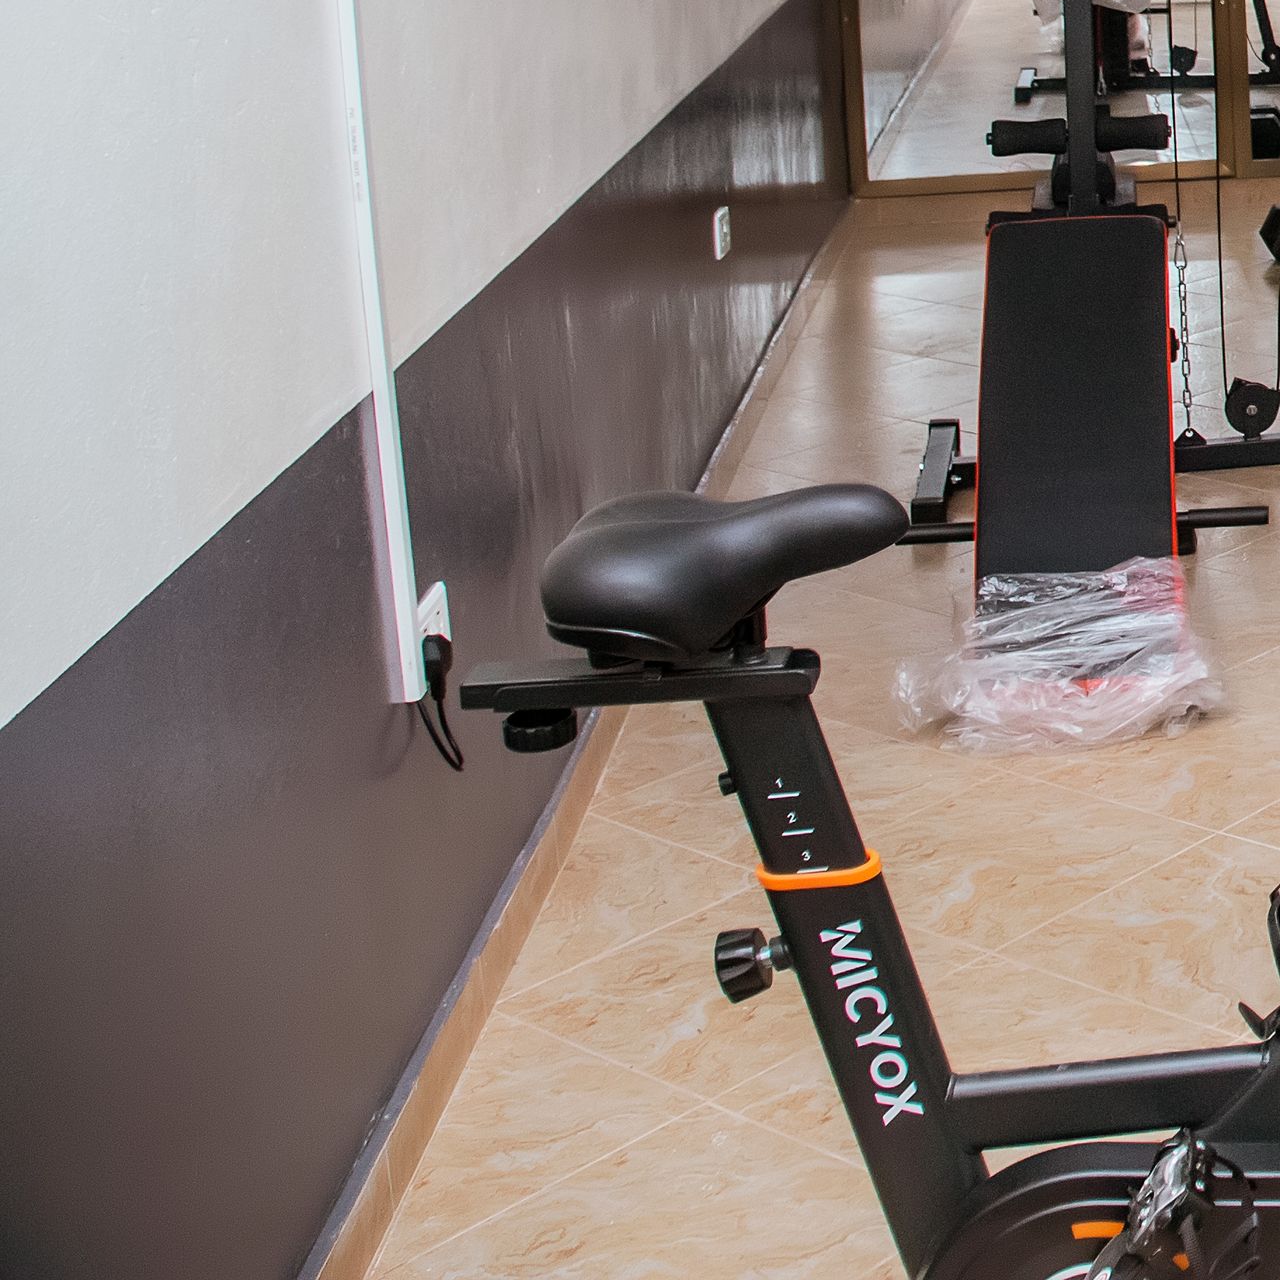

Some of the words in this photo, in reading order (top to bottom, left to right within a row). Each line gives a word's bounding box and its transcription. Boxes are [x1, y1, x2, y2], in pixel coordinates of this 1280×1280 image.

[775, 777, 782, 789] 1
[787, 811, 797, 824] 2
[801, 850, 811, 862] 3
[820, 919, 925, 1127] MICYOX
